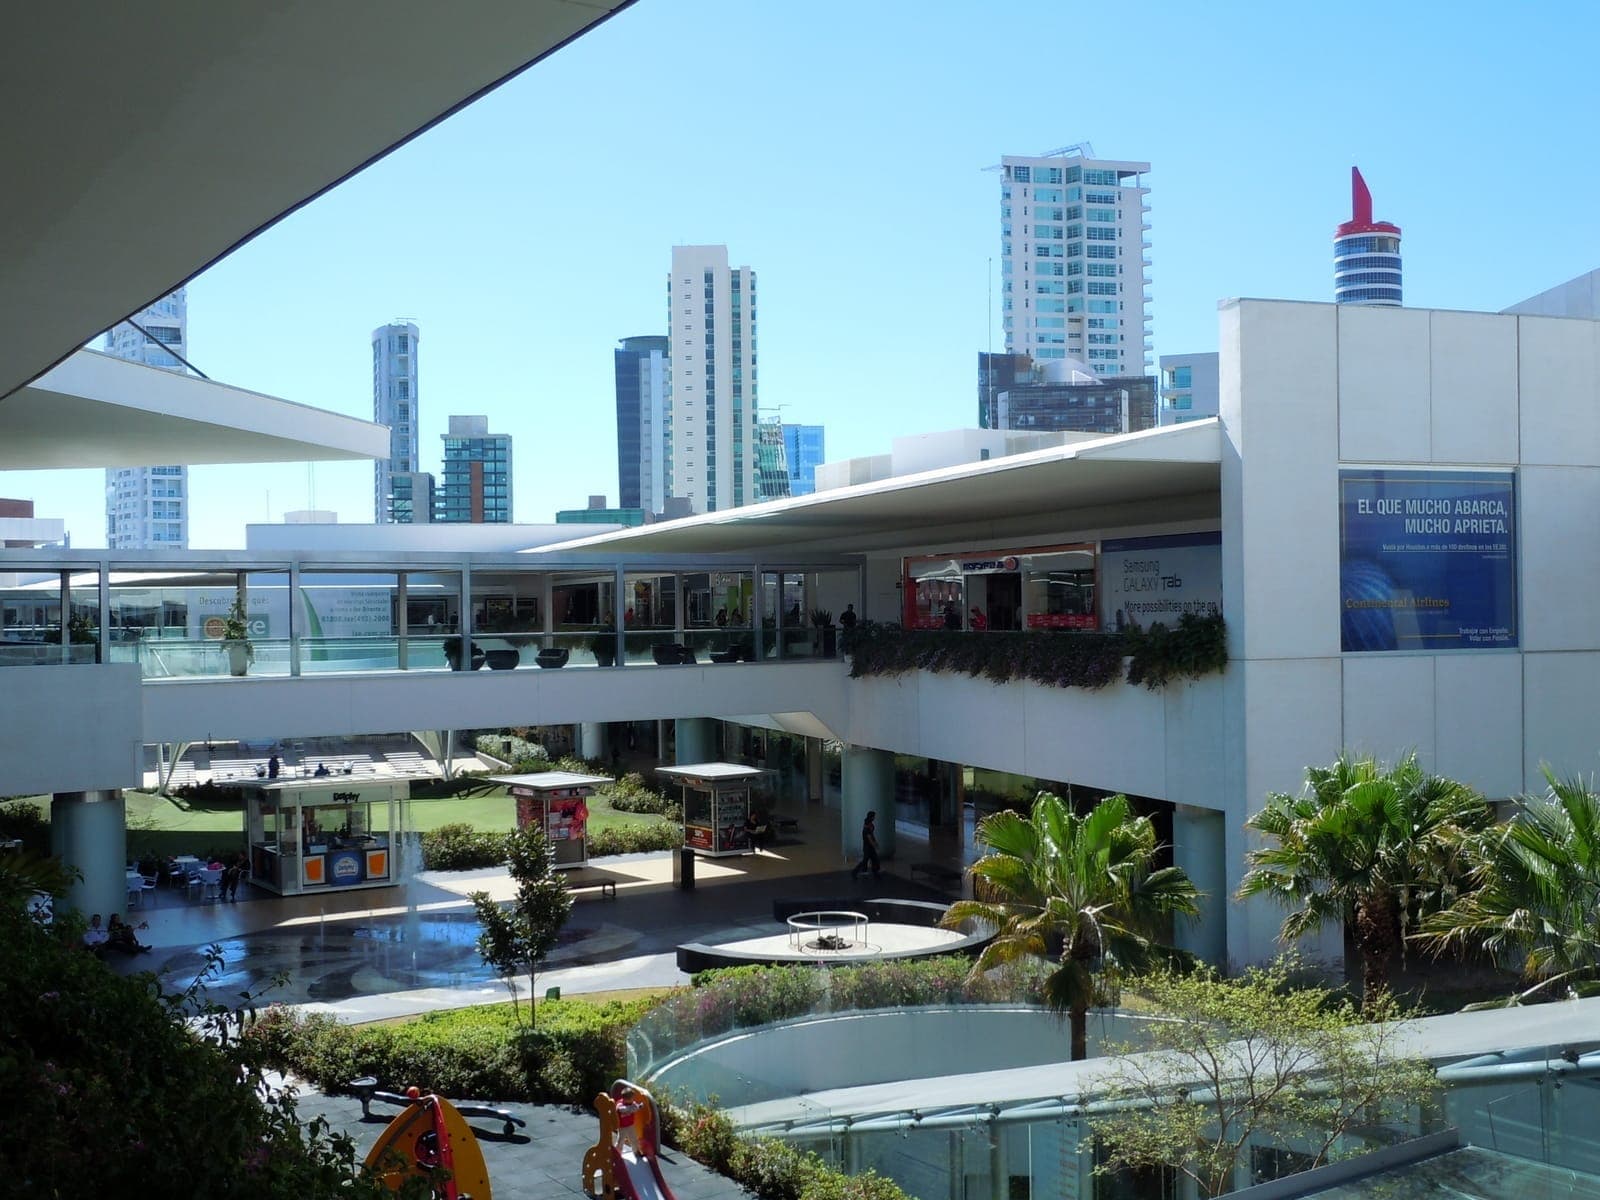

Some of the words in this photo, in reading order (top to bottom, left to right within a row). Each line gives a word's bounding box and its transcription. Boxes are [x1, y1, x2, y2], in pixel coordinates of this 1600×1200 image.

[1358, 499, 1373, 514] EL
[1377, 499, 1402, 516] QUE
[1405, 499, 1451, 515] MUCHO
[1454, 500, 1508, 518] ABARCA,
[1405, 518, 1450, 534] MUCHO
[1454, 519, 1508, 534] APRIETA.
[1123, 559, 1160, 576] Samsung
[1123, 576, 1159, 592] GALAXY
[1160, 573, 1182, 591] Tab
[1124, 600, 1141, 612] More
[1142, 599, 1182, 615] possibilities
[1183, 602, 1192, 612] on
[1193, 600, 1206, 612] the
[1345, 597, 1408, 609] Continental
[1410, 596, 1450, 608] Airlines
